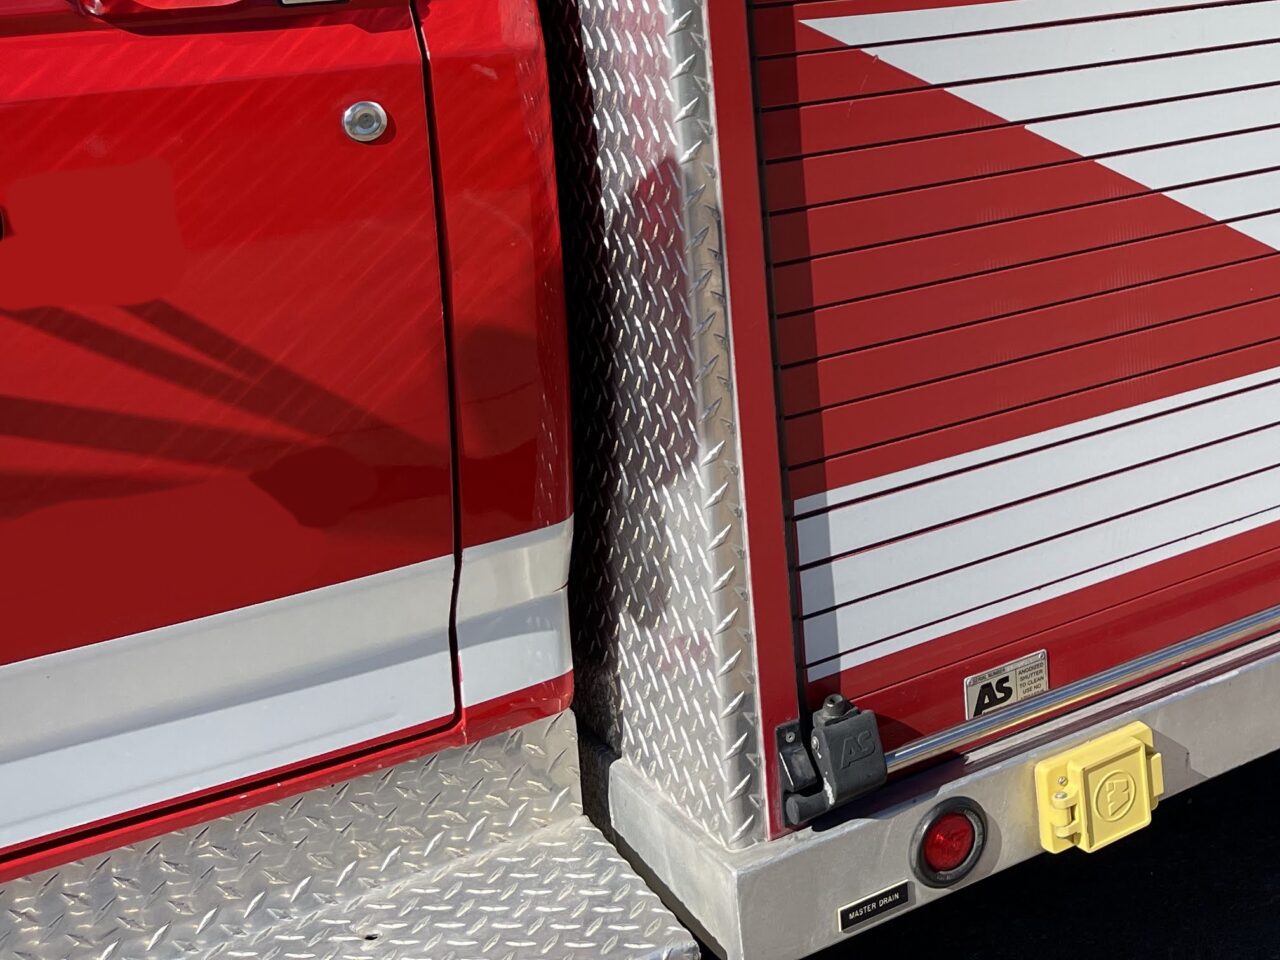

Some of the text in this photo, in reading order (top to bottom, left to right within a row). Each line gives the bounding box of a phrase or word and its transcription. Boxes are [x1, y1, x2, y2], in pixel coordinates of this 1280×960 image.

[973, 675, 1013, 717] AS
[841, 731, 876, 769] AS
[848, 892, 900, 920] MASTER DRAIN
